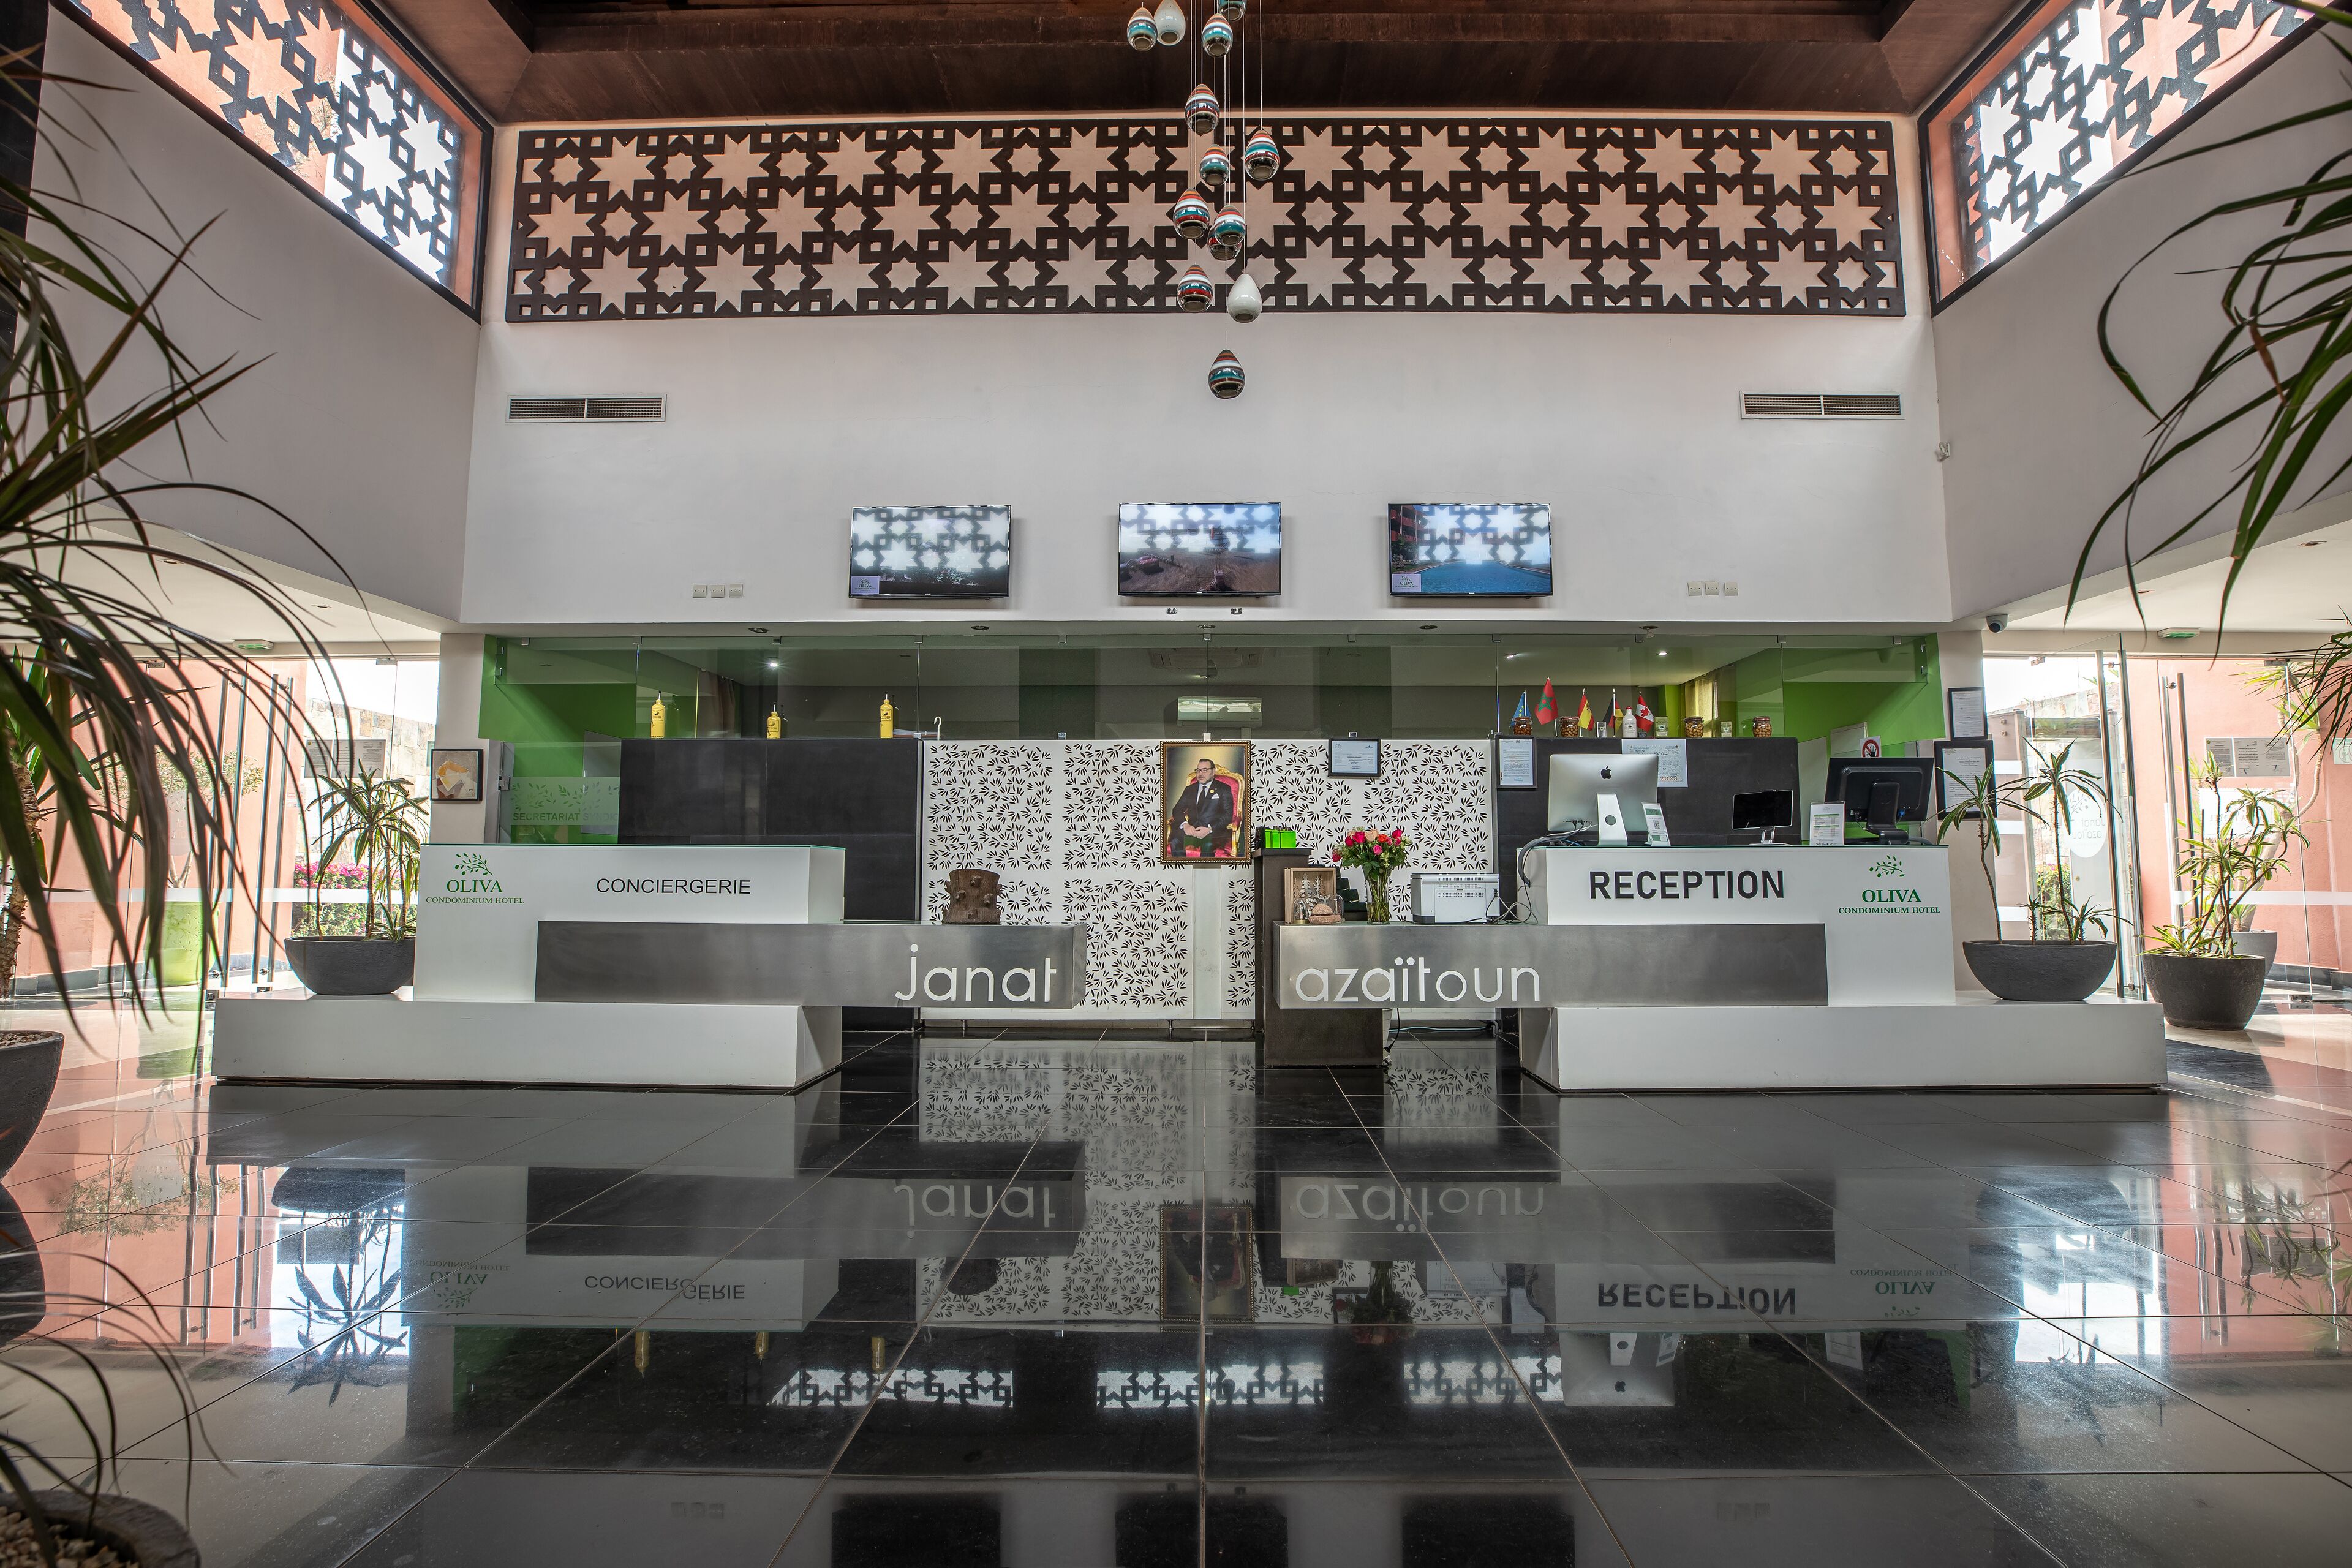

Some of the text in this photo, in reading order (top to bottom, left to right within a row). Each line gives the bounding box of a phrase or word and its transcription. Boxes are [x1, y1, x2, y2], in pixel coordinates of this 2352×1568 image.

[513, 813, 580, 821] SECRETARIAT
[446, 880, 503, 894] OLIVA
[596, 878, 752, 895] CONCIERGERIE
[1589, 869, 1785, 900] RECEPTION
[1861, 888, 1921, 903] OLIVA
[895, 943, 1057, 1003] janat
[1295, 957, 1541, 1003] azaïtoun
